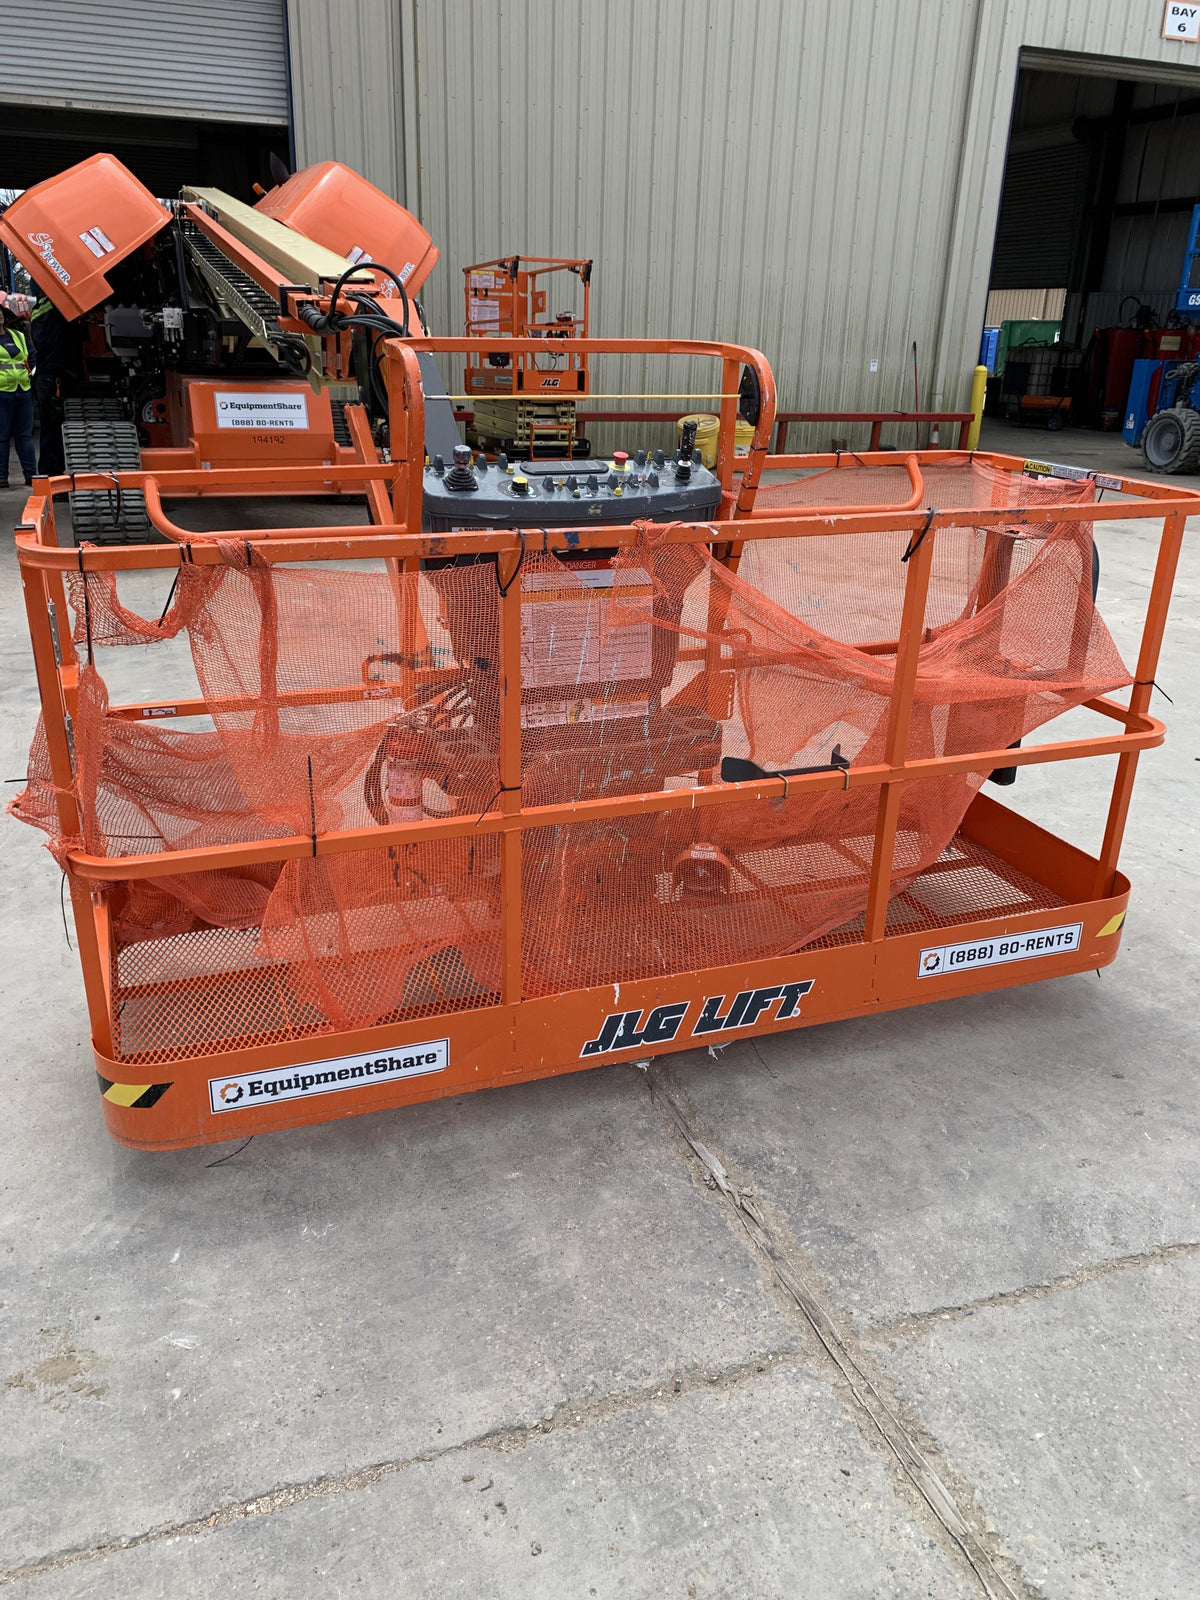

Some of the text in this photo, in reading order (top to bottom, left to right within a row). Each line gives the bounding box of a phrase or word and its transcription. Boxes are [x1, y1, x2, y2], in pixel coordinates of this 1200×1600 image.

[1171, 6, 1197, 18] BAY
[1177, 22, 1187, 33] 6
[541, 378, 560, 387] JLG
[229, 402, 302, 411] EquipmentShare
[231, 419, 294, 427] (888) 80-RENTS
[252, 435, 286, 444] 194192
[1029, 461, 1051, 474] CAUTION
[566, 561, 597, 570] DANGER
[949, 931, 1074, 966] (888) 80-RENTS
[579, 979, 816, 1058] JLG LIFT
[247, 1050, 439, 1098] EquipmentShare
